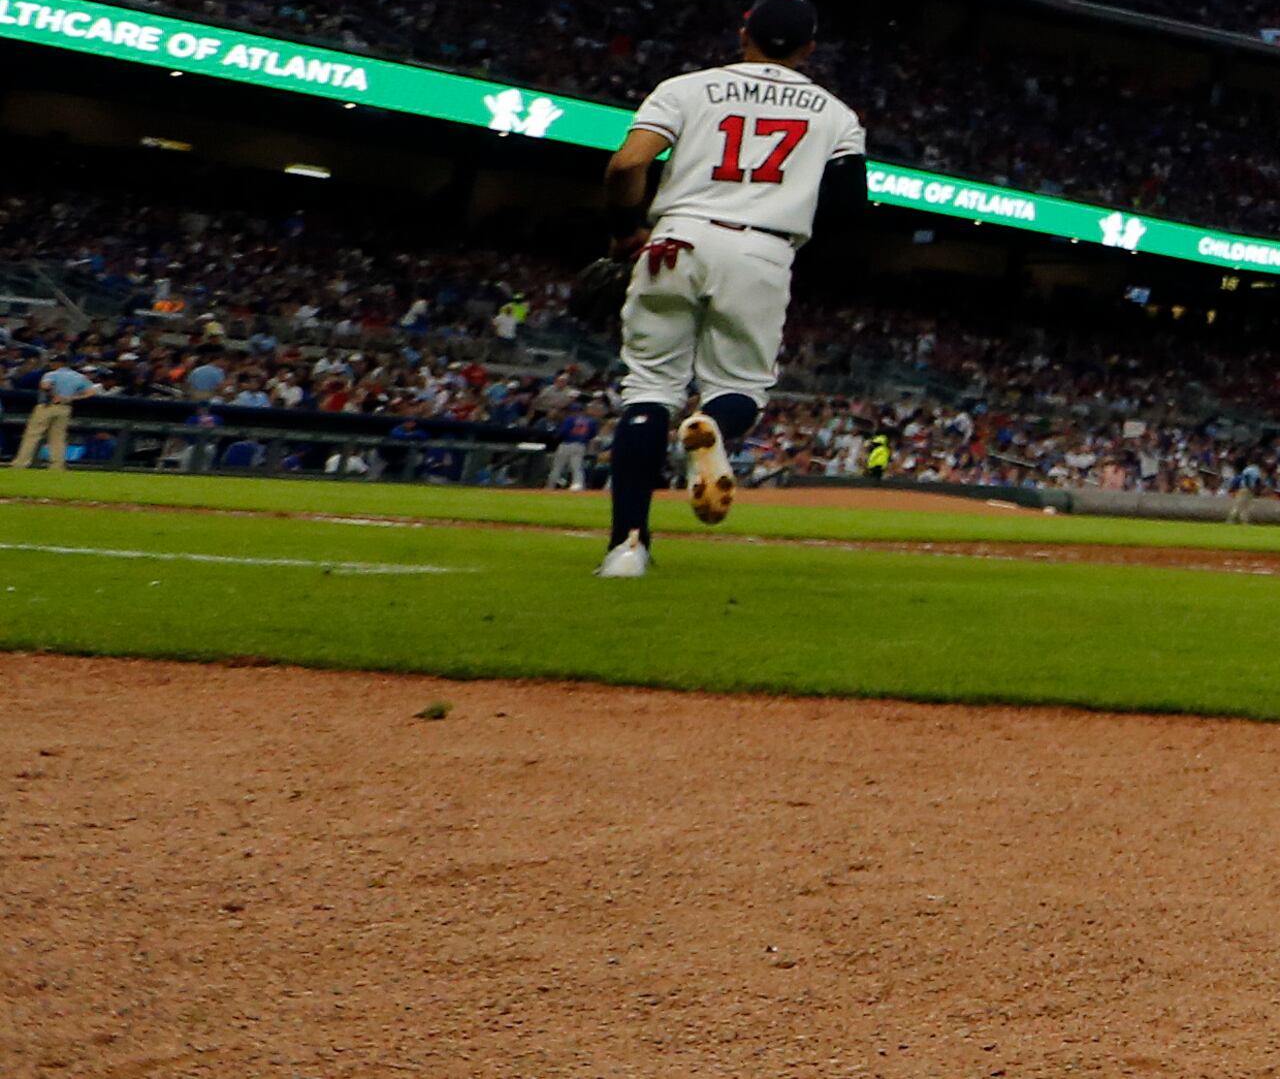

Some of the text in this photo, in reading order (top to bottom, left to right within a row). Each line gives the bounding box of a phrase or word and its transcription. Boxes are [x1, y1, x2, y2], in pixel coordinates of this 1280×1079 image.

[167, 32, 221, 60] OF
[221, 44, 367, 91] ATLANTA
[706, 82, 827, 113] CAMARGO
[712, 114, 809, 184] 17
[866, 171, 1035, 221] CARE OF ATLANTA
